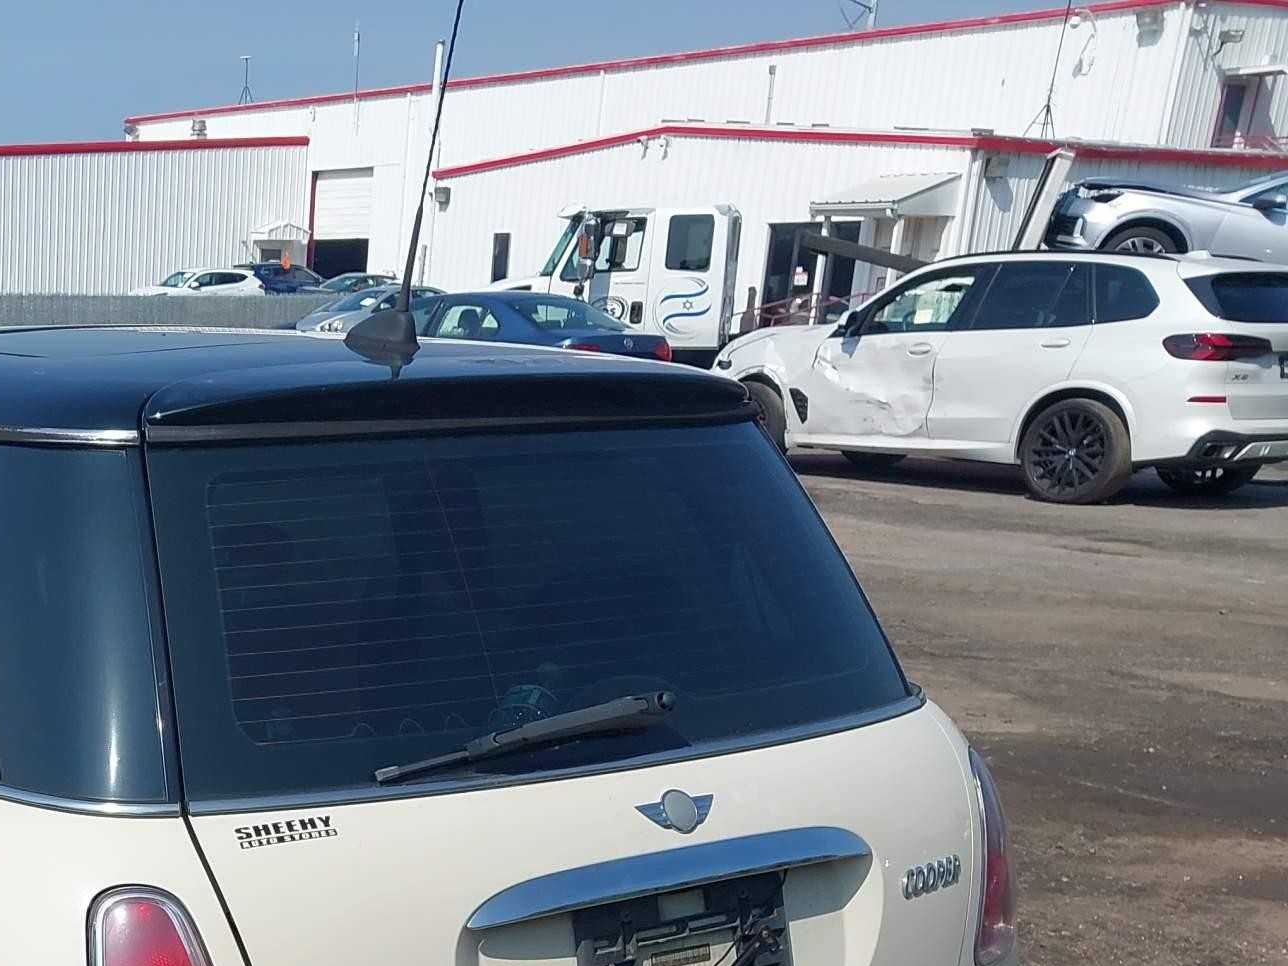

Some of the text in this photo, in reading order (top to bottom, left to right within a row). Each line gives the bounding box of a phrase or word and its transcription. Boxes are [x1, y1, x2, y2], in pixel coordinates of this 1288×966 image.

[234, 815, 331, 841] SHEEHY
[241, 829, 338, 849] AUTO STORES
[901, 853, 962, 901] COOPER
